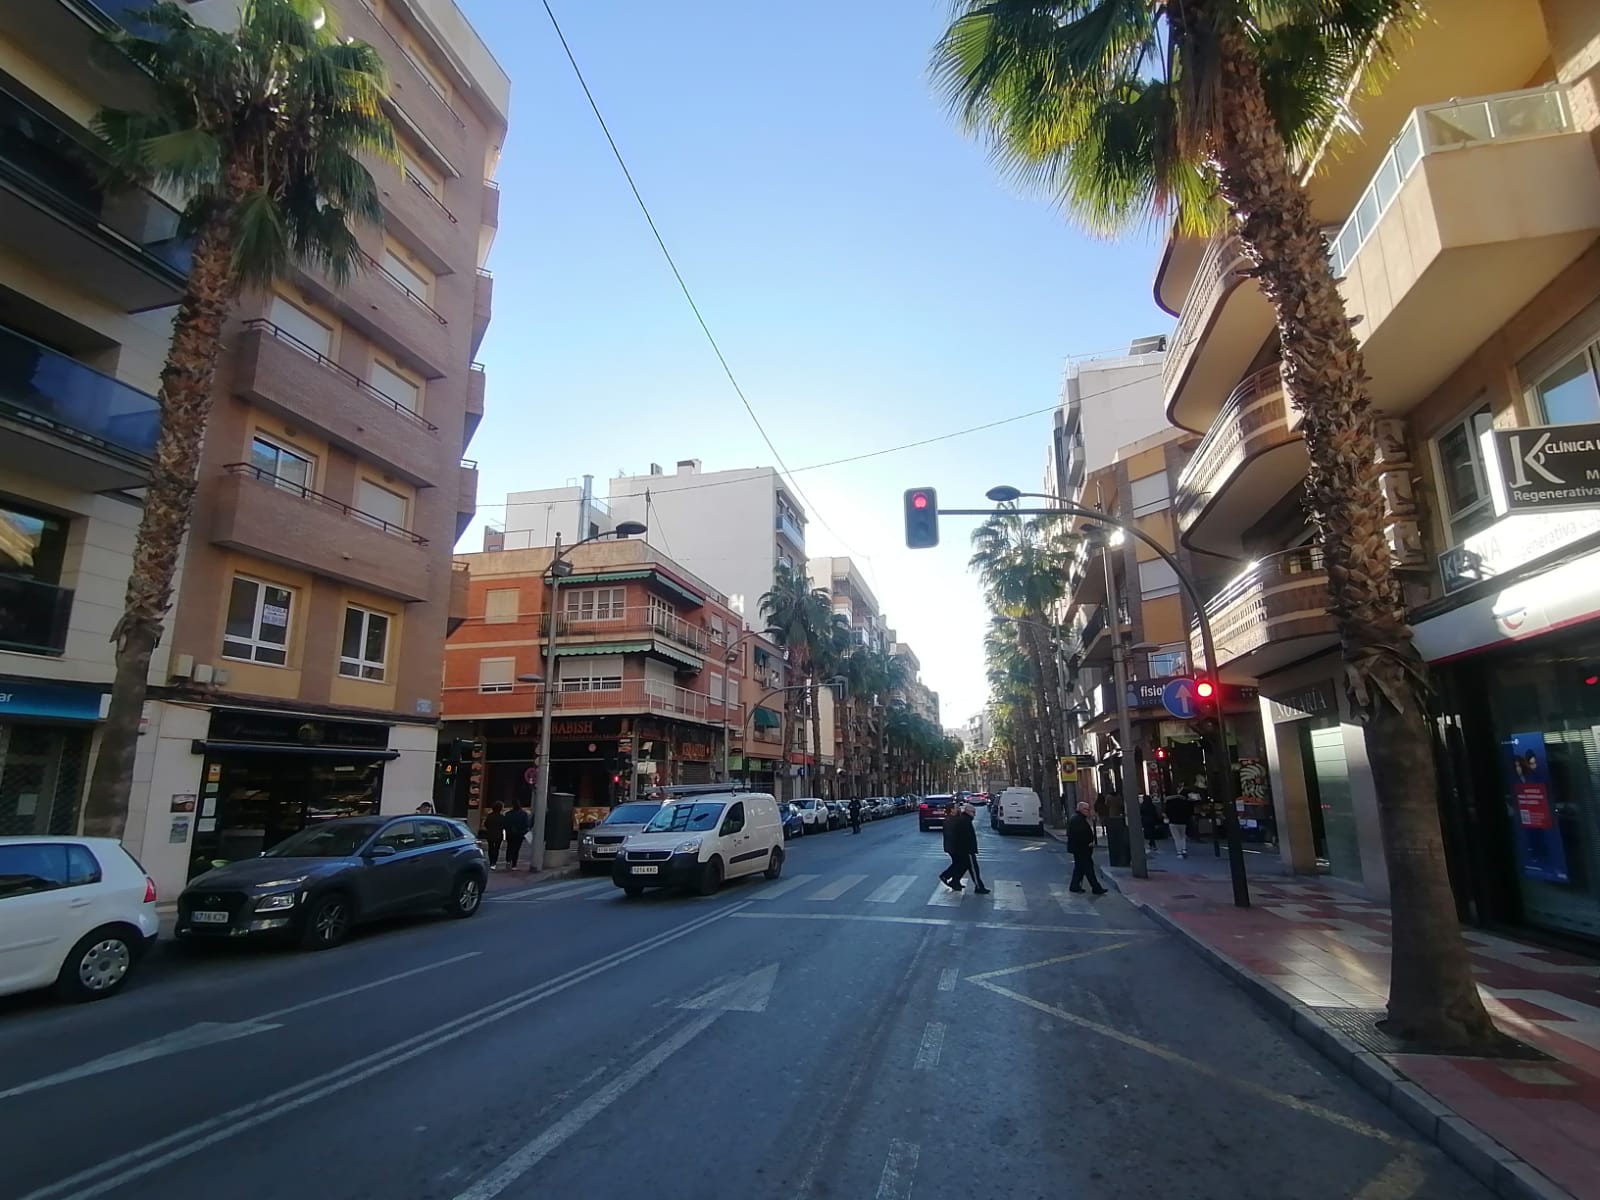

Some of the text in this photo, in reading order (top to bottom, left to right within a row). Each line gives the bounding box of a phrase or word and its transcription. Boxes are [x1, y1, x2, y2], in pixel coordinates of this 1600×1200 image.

[1544, 440, 1594, 454] CLÍNICA
[1513, 486, 1600, 503] Regenerativa
[1443, 535, 1503, 582] KHNA
[1140, 684, 1167, 697] fisio
[536, 720, 593, 734] KBABISH
